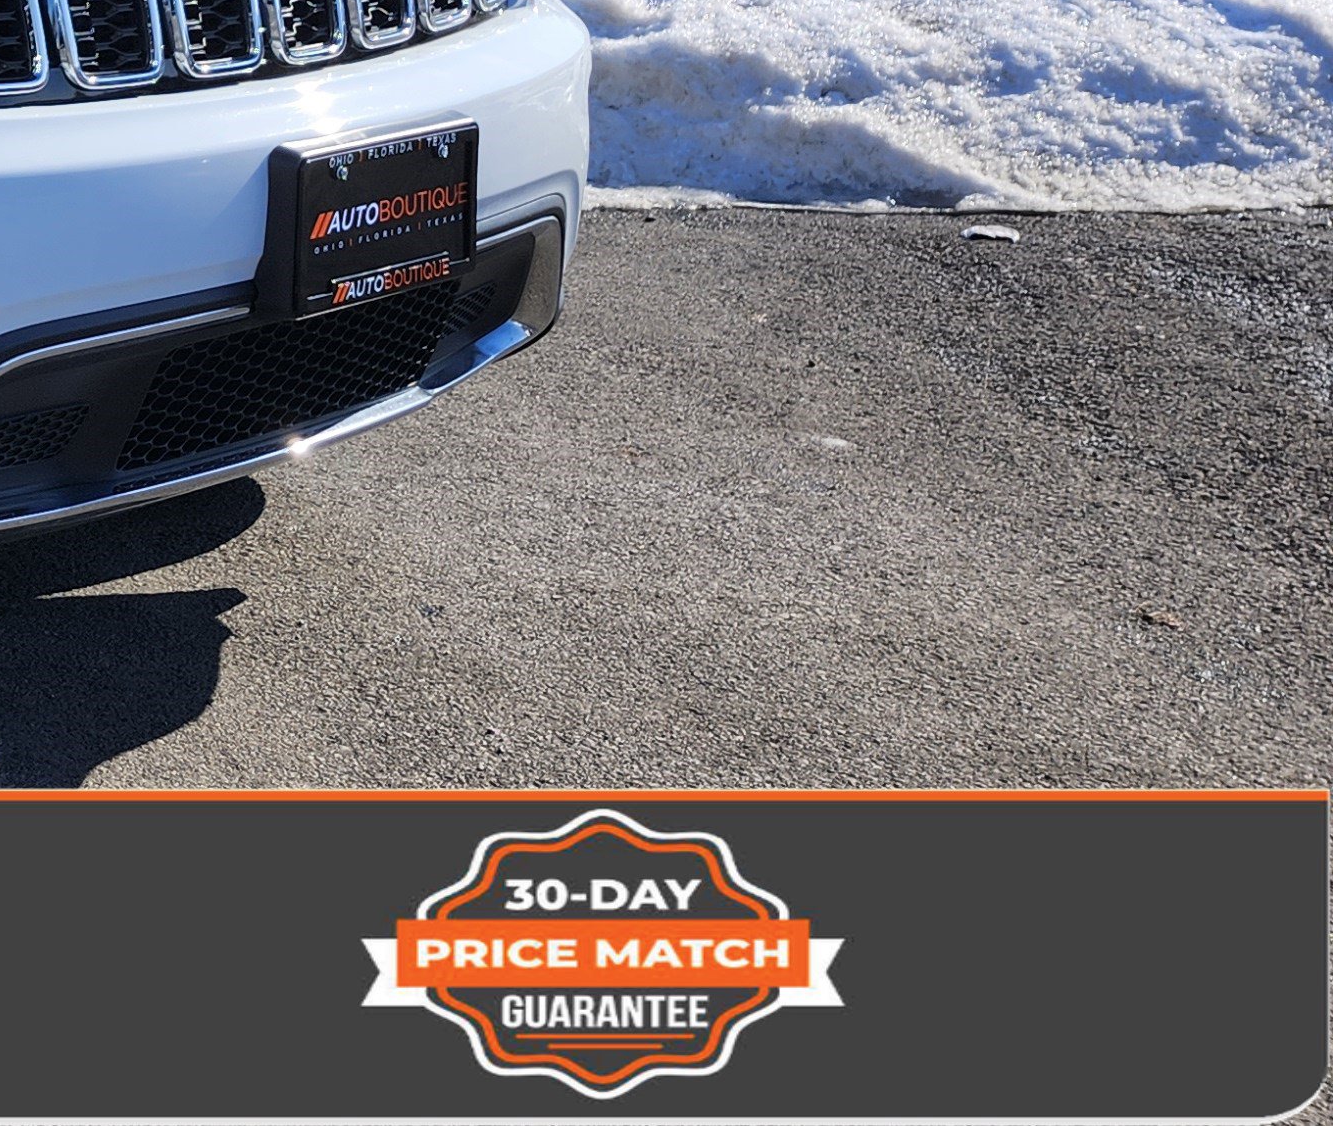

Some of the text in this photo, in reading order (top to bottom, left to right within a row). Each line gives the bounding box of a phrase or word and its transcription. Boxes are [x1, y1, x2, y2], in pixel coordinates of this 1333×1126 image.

[329, 133, 457, 169] OHIO FLORIDA TEXAS
[327, 182, 469, 235] AUTOBOUTIQUE
[314, 213, 464, 255] OHIO FLORIDA TEXAS
[346, 258, 451, 301] AUTOBOUTIQUE
